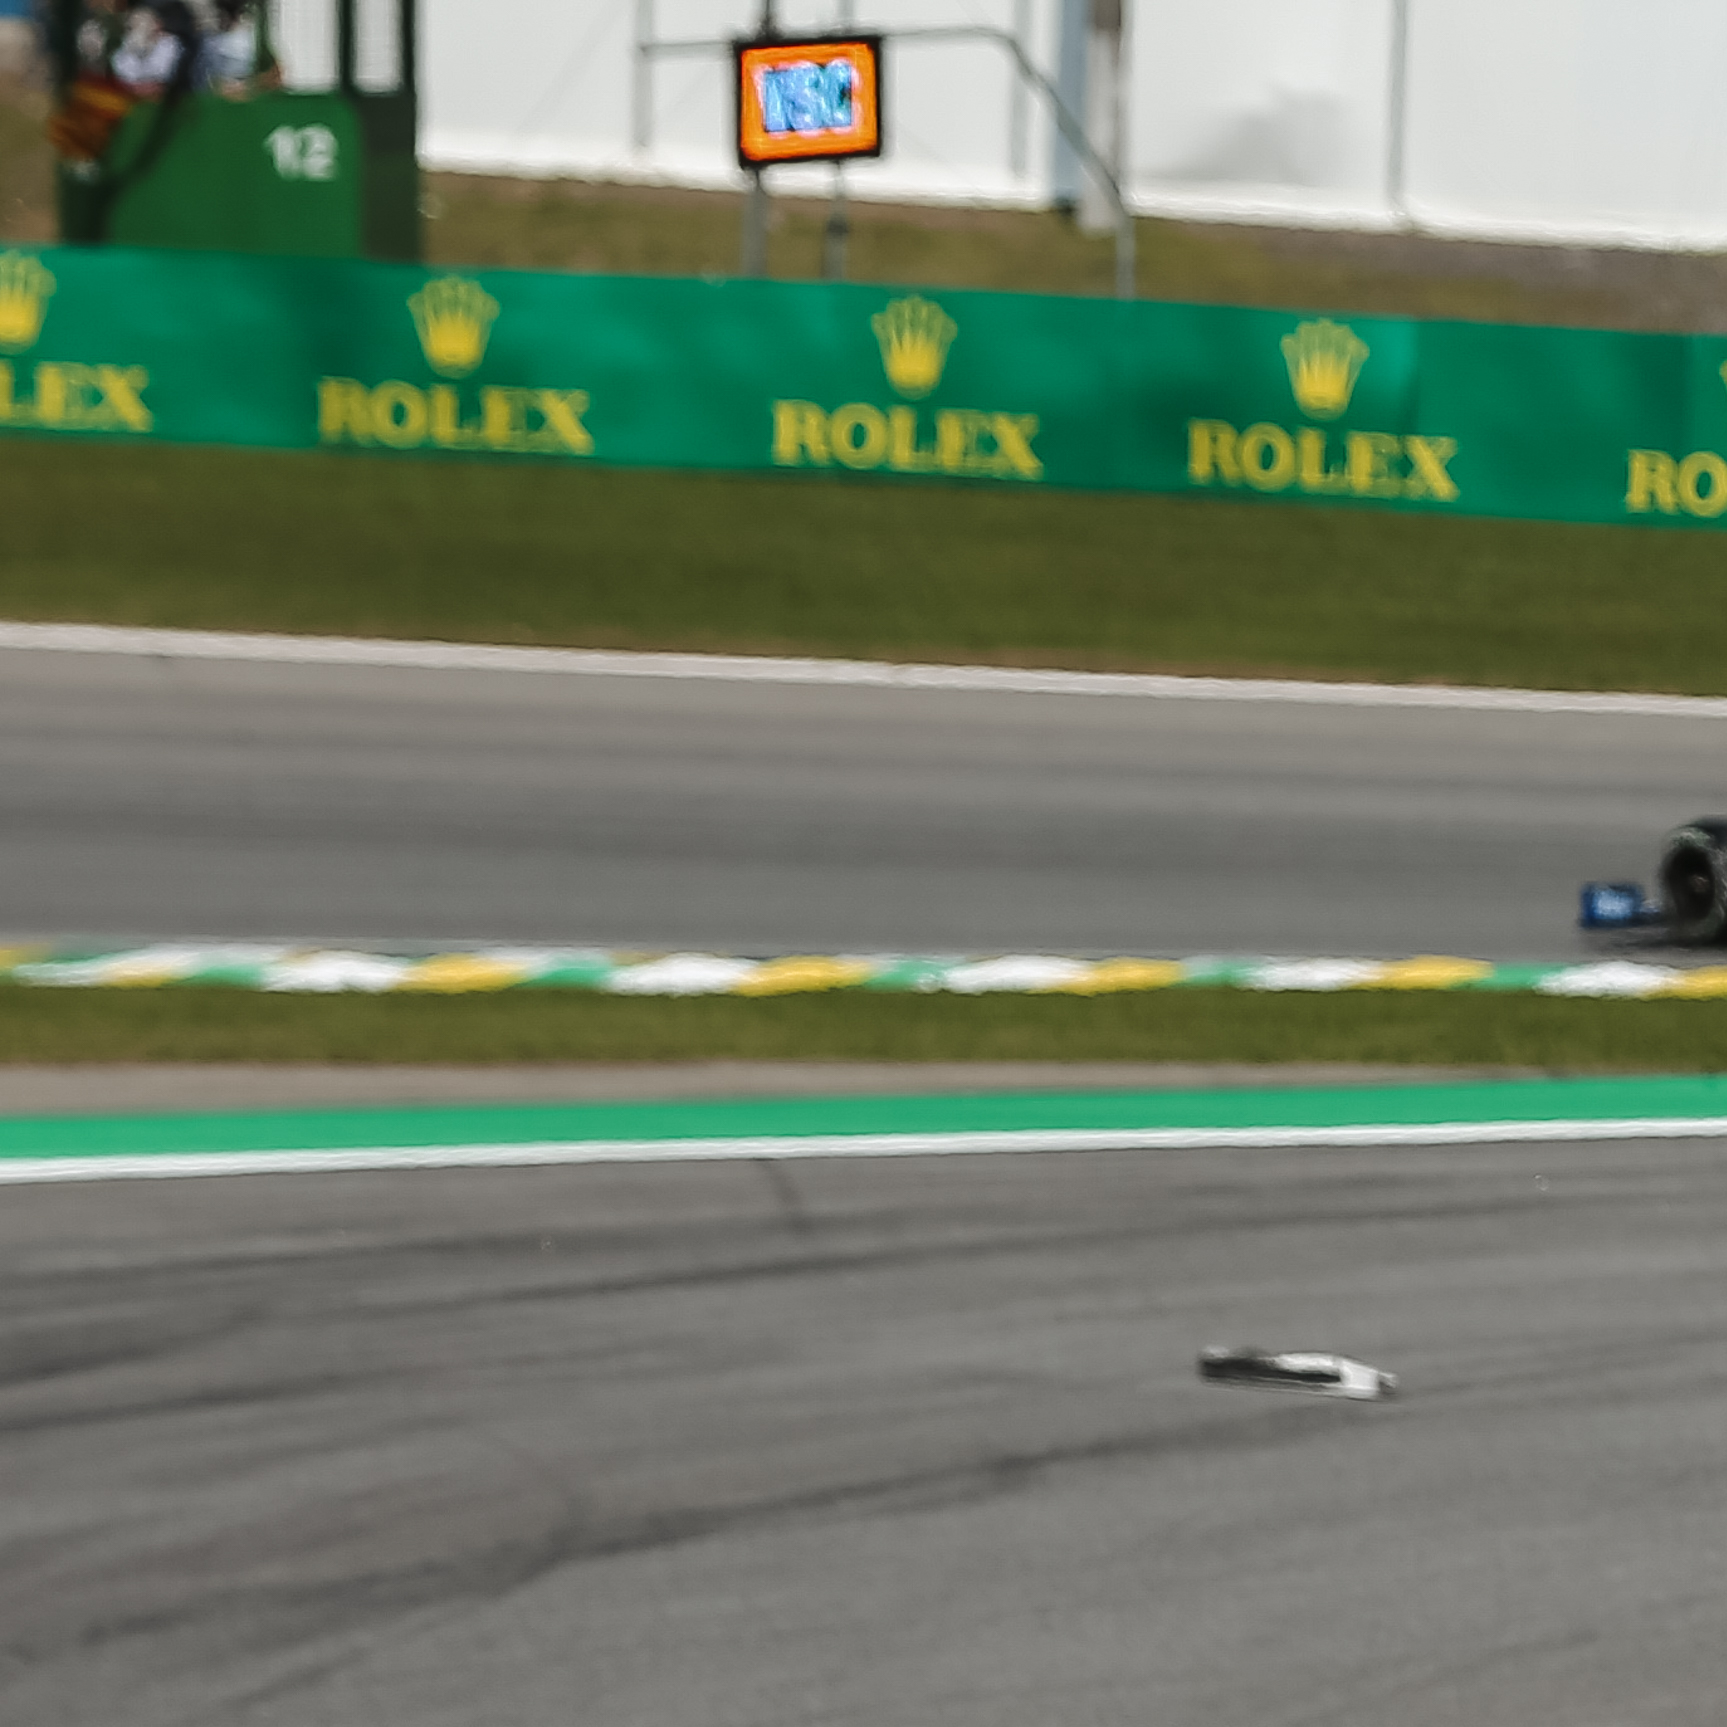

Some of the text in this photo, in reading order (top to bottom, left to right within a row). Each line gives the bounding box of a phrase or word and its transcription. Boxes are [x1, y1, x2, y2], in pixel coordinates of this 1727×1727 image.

[263, 123, 340, 180] 12
[318, 377, 595, 457] ROLEX
[772, 400, 1045, 480] ROLEX
[1188, 419, 1459, 502] ROLEX
